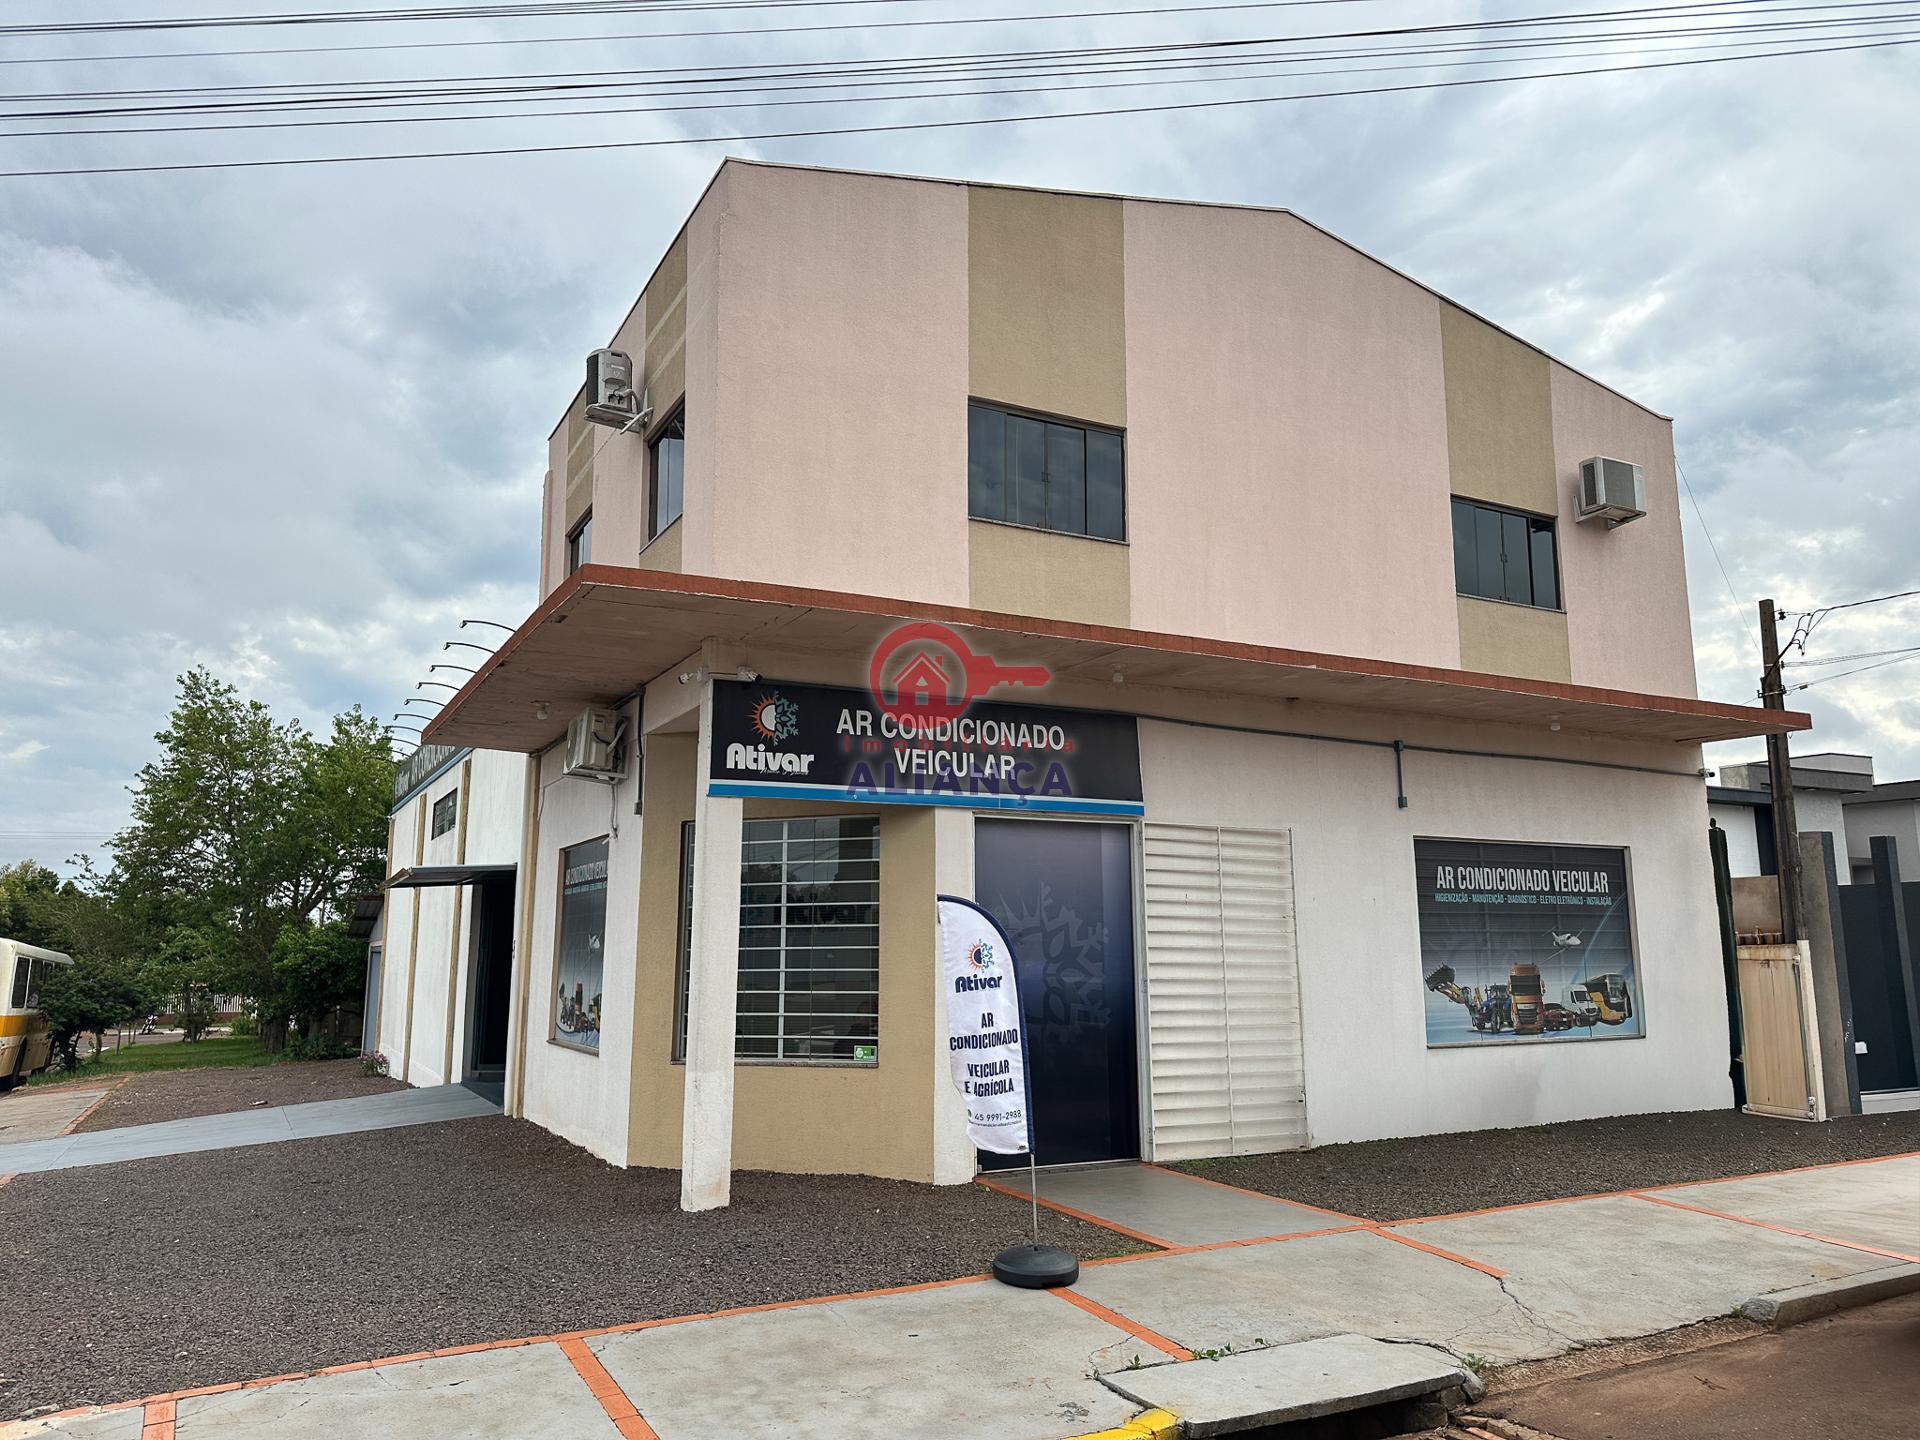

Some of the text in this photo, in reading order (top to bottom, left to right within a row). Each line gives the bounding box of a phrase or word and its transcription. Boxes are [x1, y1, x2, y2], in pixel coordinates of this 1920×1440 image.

[836, 708, 1065, 750] AR CONDICIONADO
[726, 742, 815, 772] Ativar
[894, 748, 1016, 780] VEICULAR
[1436, 865, 1609, 893] AR CONDICIONADO VEICULAR
[955, 974, 1003, 993] Ativar
[981, 1012, 994, 1028] AR
[949, 1028, 1018, 1051] CONDICIONADO
[967, 1059, 1010, 1078] VEICULAR
[964, 1078, 1014, 1097] E AGRÍCOLA
[974, 1113, 985, 1121] 45
